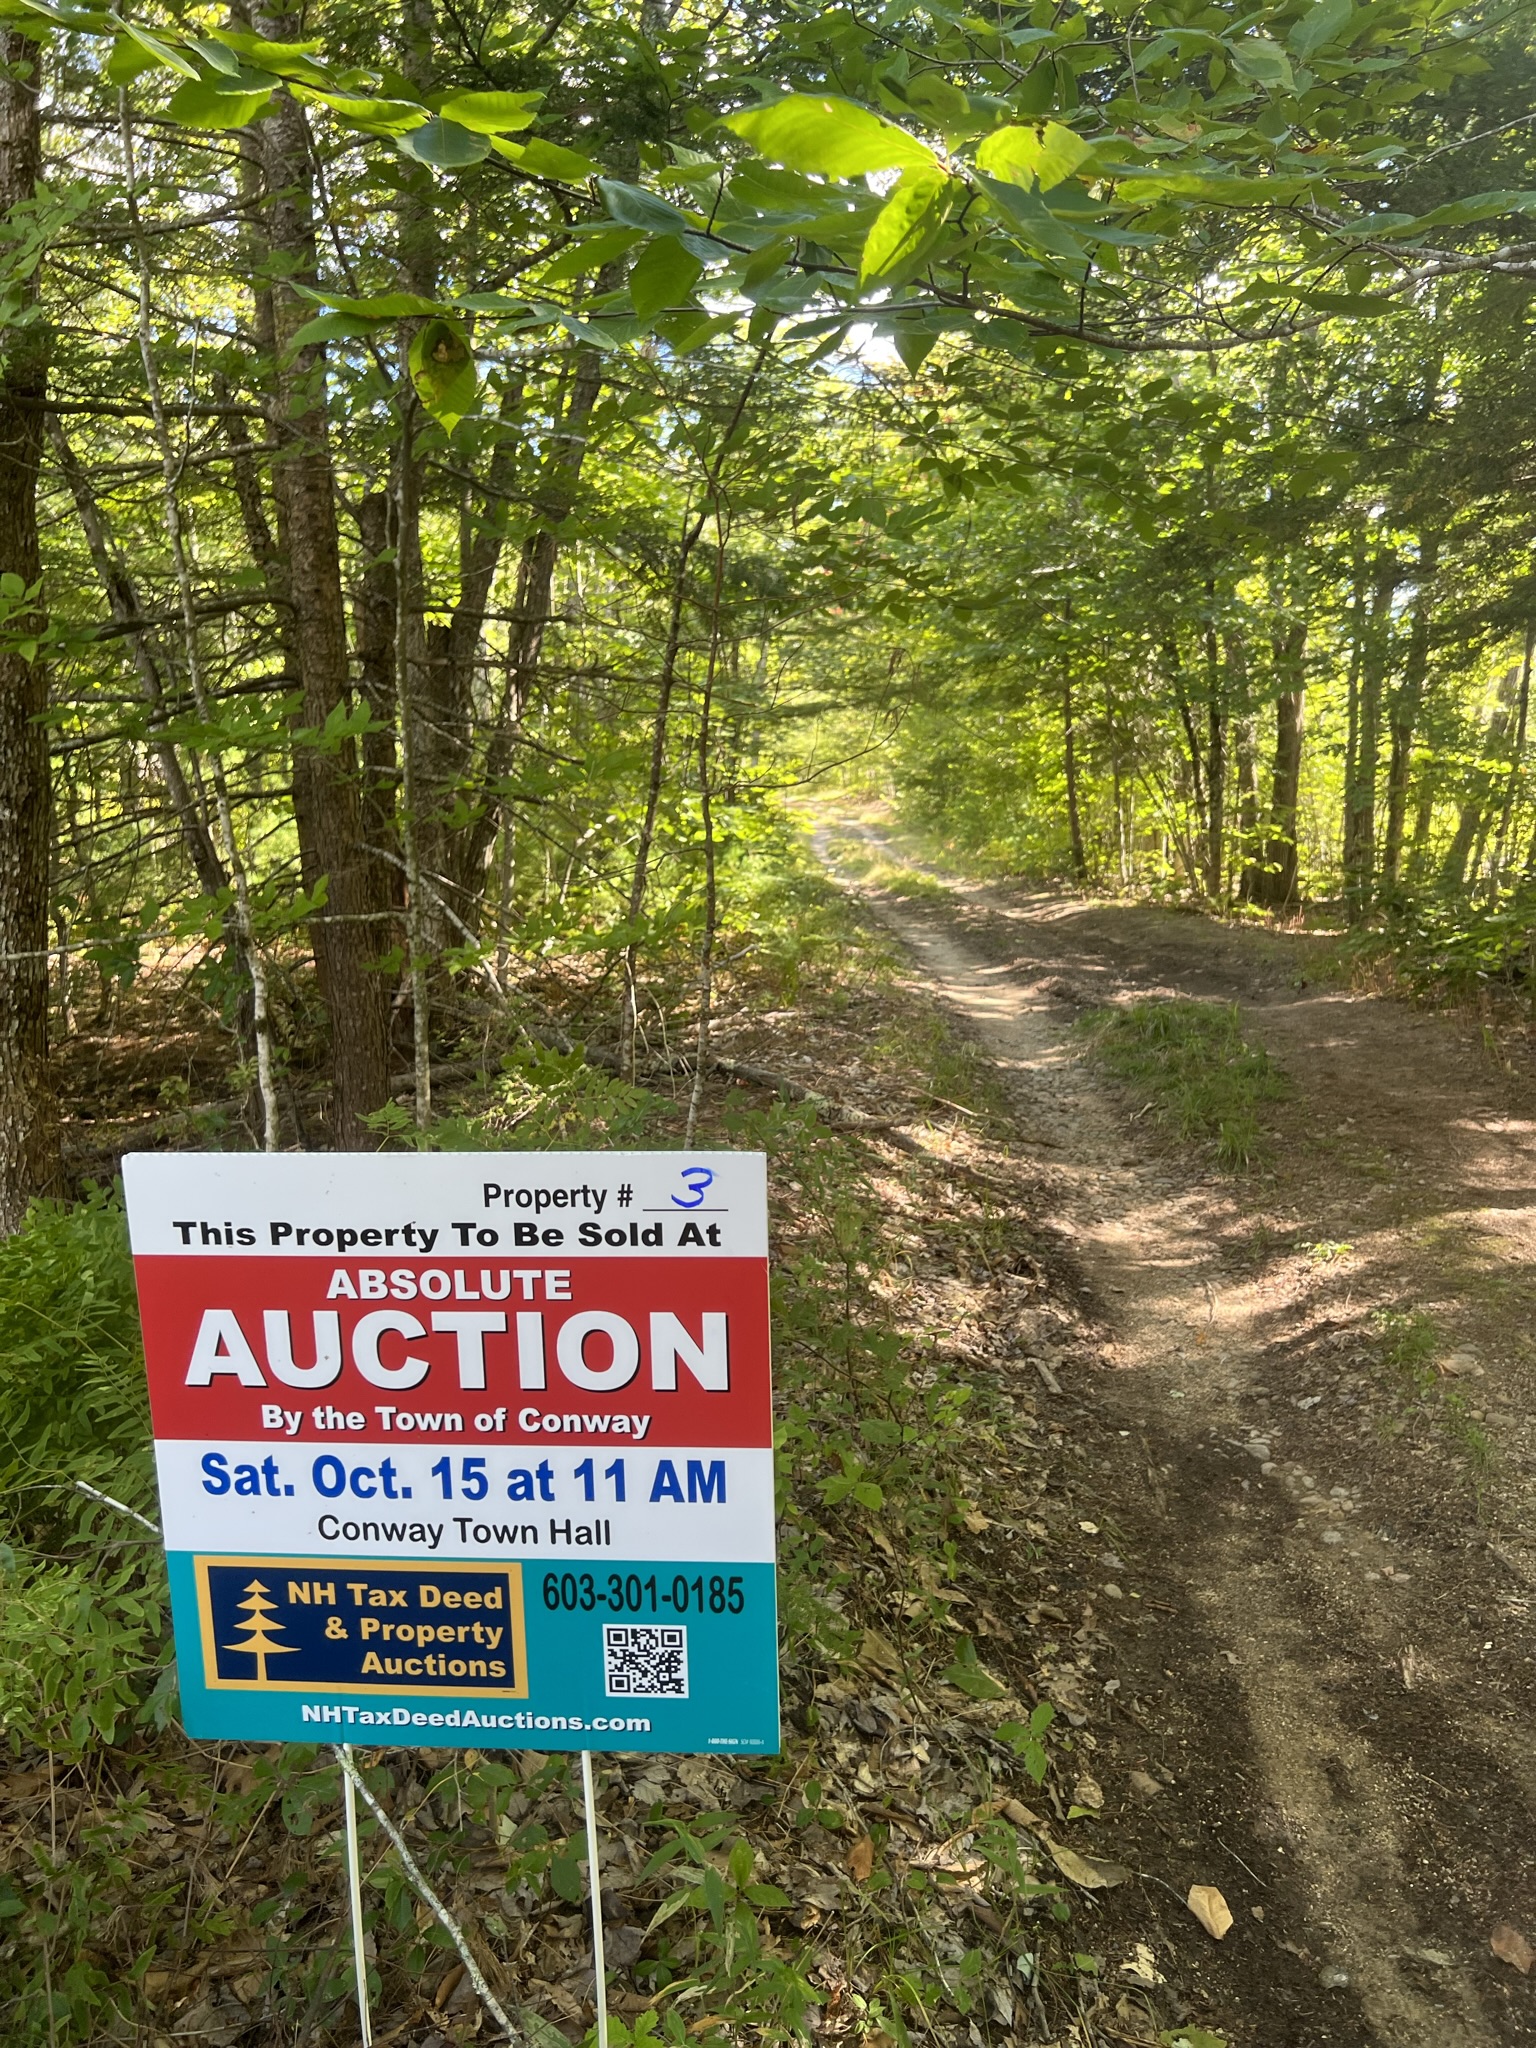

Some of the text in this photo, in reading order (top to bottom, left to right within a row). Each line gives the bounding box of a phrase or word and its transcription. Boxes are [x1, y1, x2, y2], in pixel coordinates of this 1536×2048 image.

[483, 1182, 633, 1214] Property #
[670, 1168, 718, 1208] 3
[173, 1222, 721, 1253] This Property To Be Sold At
[327, 1269, 573, 1301] ABSOLUTE
[184, 1309, 730, 1393] AUCTION
[261, 1405, 650, 1439] By the Town of Conway
[201, 1452, 727, 1504] Sat. Oct. 15 at 11 AM
[318, 1515, 611, 1549] Conway Town Hall
[287, 1581, 502, 1610] NH Tax Deed
[543, 1572, 745, 1614] 603-301-0185
[325, 1618, 504, 1648] & Property
[361, 1652, 506, 1679] Auctions
[302, 1705, 651, 1732] NHTaxDeedAuctions.com
